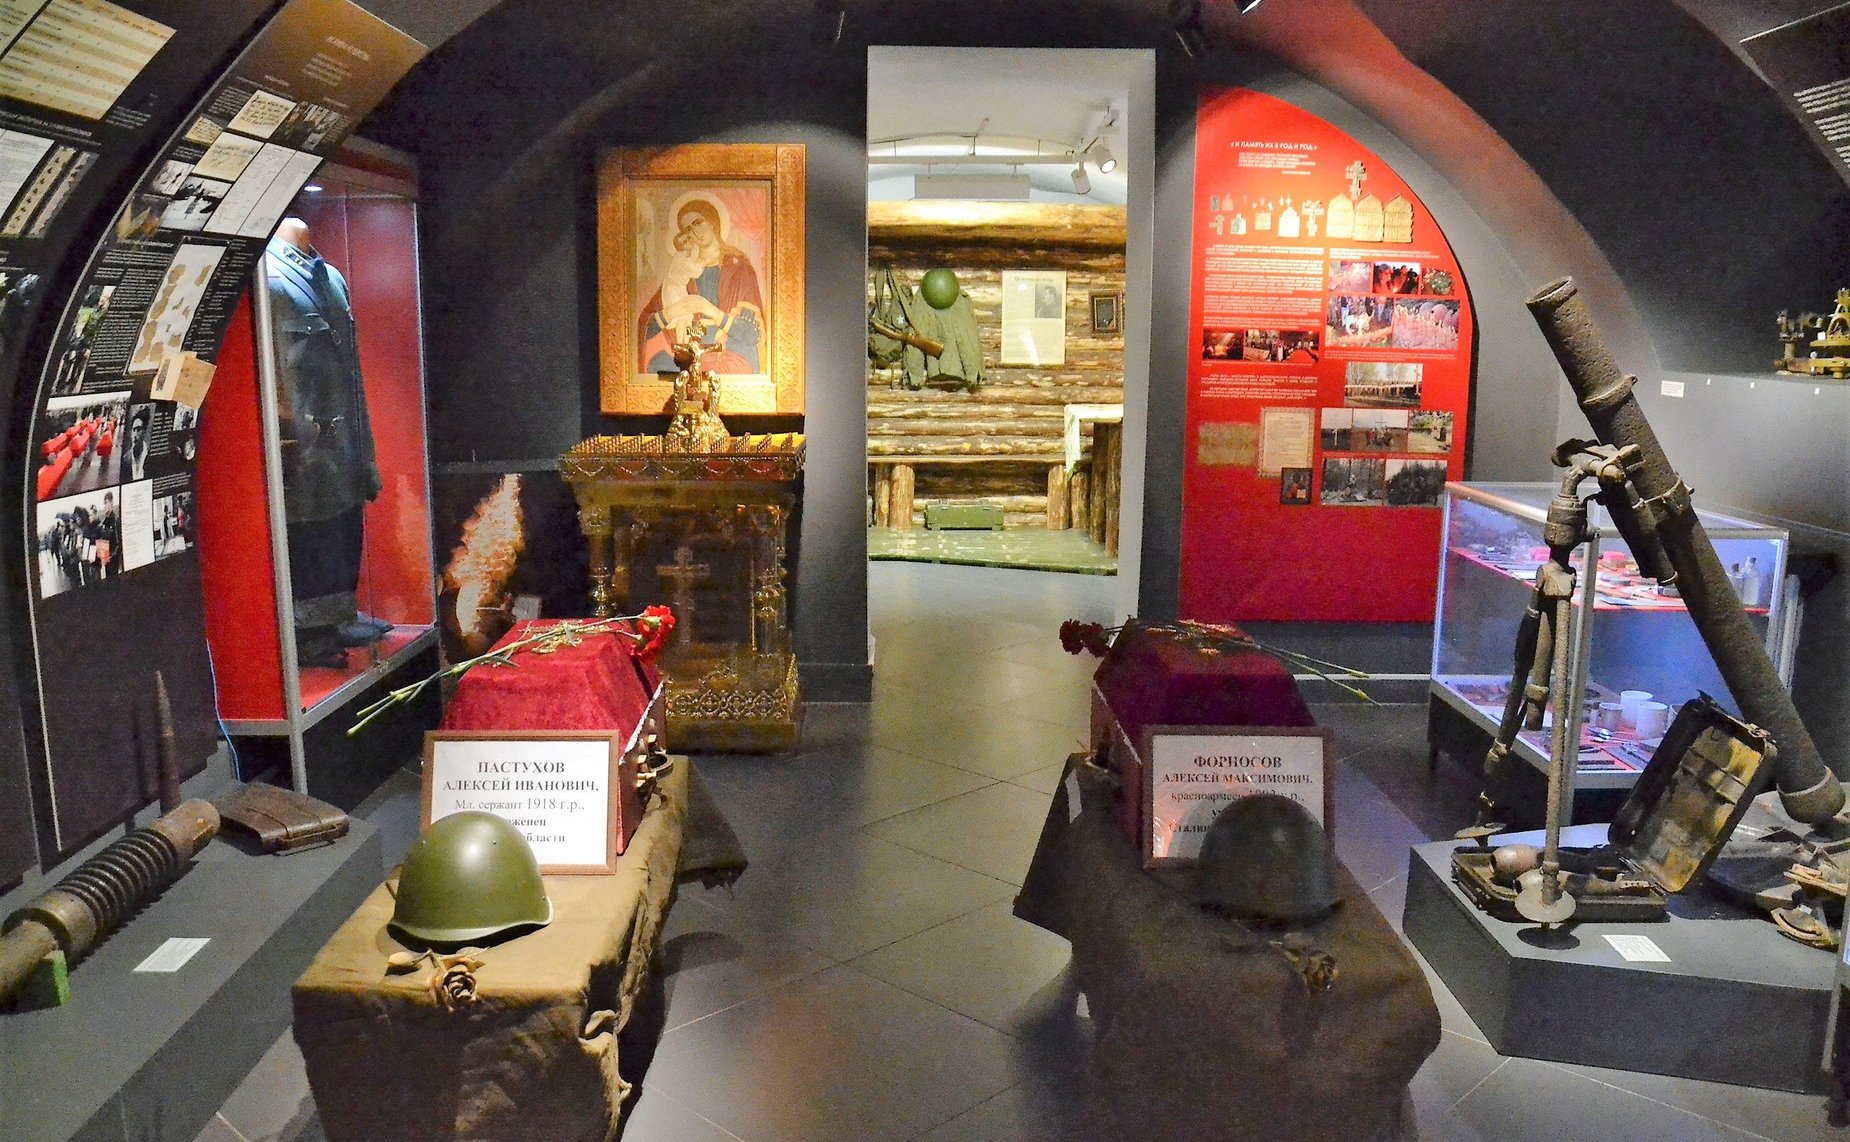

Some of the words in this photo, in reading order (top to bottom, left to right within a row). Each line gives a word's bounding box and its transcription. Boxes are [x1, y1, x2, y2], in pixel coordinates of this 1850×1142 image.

[1241, 141, 1265, 149] ПАМЯТЬ
[1280, 142, 1293, 151] РОД
[478, 762, 565, 773] ПАСТУХОВ
[1194, 756, 1282, 768] ФОРНОСОВ
[1162, 772, 1219, 783] АЛЕКСЕЙ
[442, 778, 511, 791] АЛЕКСЕЙ
[455, 800, 475, 810] Мл.
[478, 800, 522, 812] сержант
[527, 798, 556, 810] 1918
[524, 832, 566, 842] бласти
